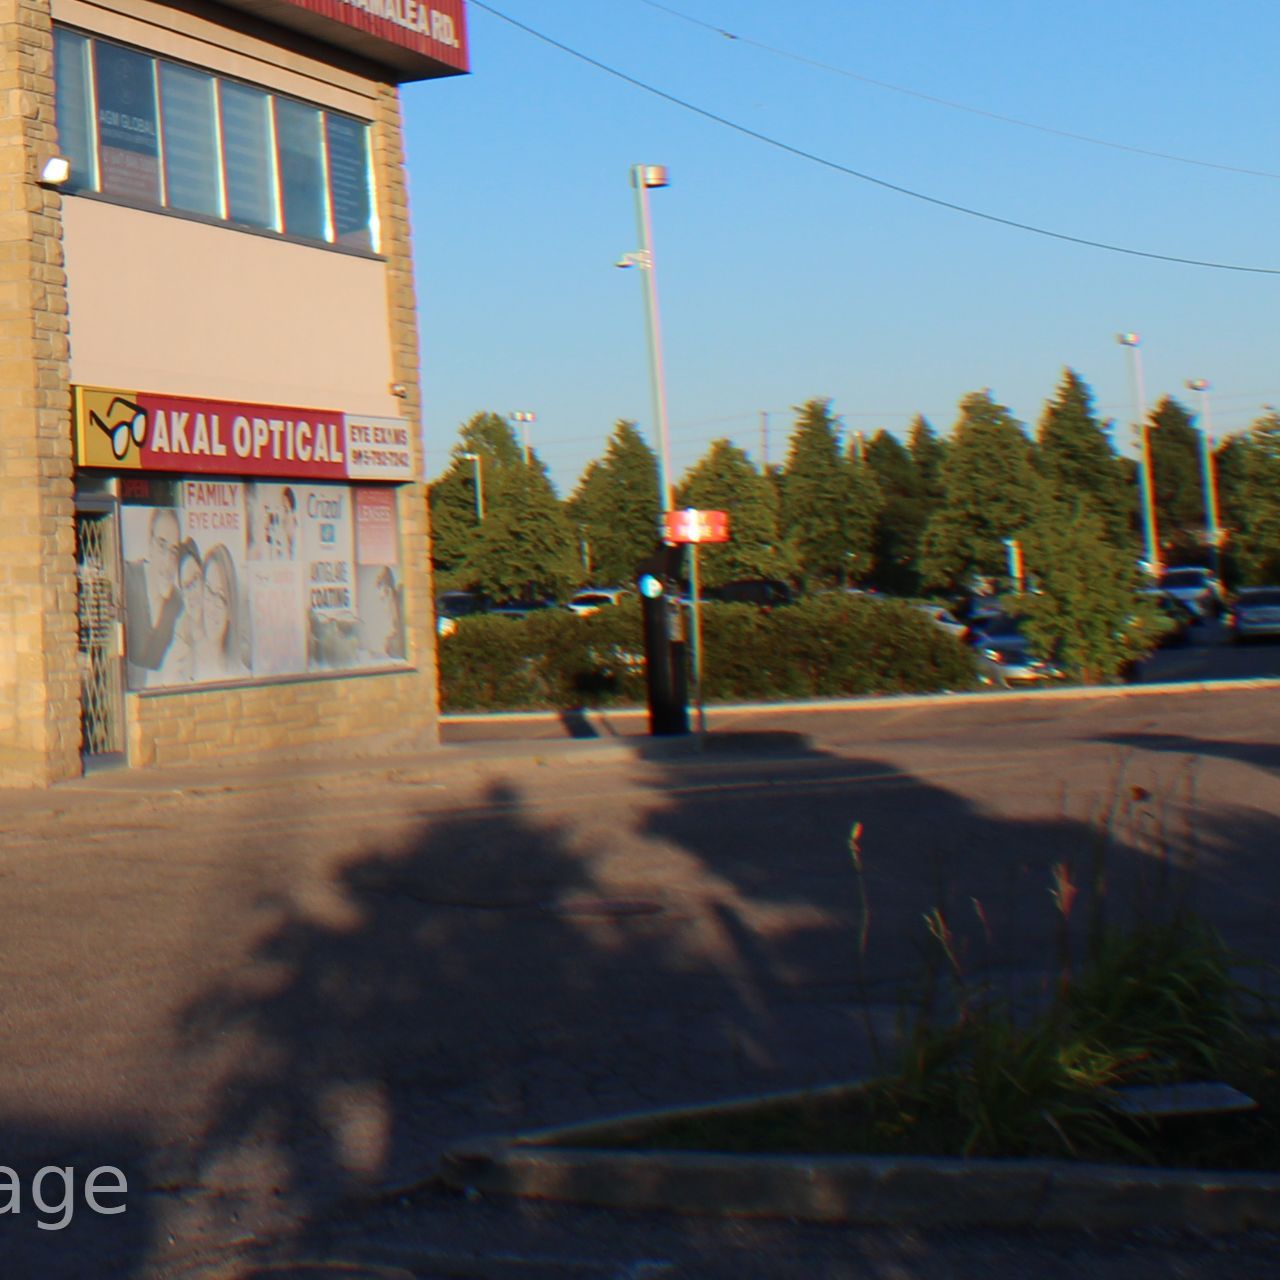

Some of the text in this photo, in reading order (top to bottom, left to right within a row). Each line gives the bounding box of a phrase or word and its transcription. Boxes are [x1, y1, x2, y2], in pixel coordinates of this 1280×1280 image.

[150, 409, 344, 464] AKAL OPTICAL
[350, 424, 372, 443] EYE
[186, 482, 239, 507] FAMILY
[189, 511, 240, 530] EYE CARE
